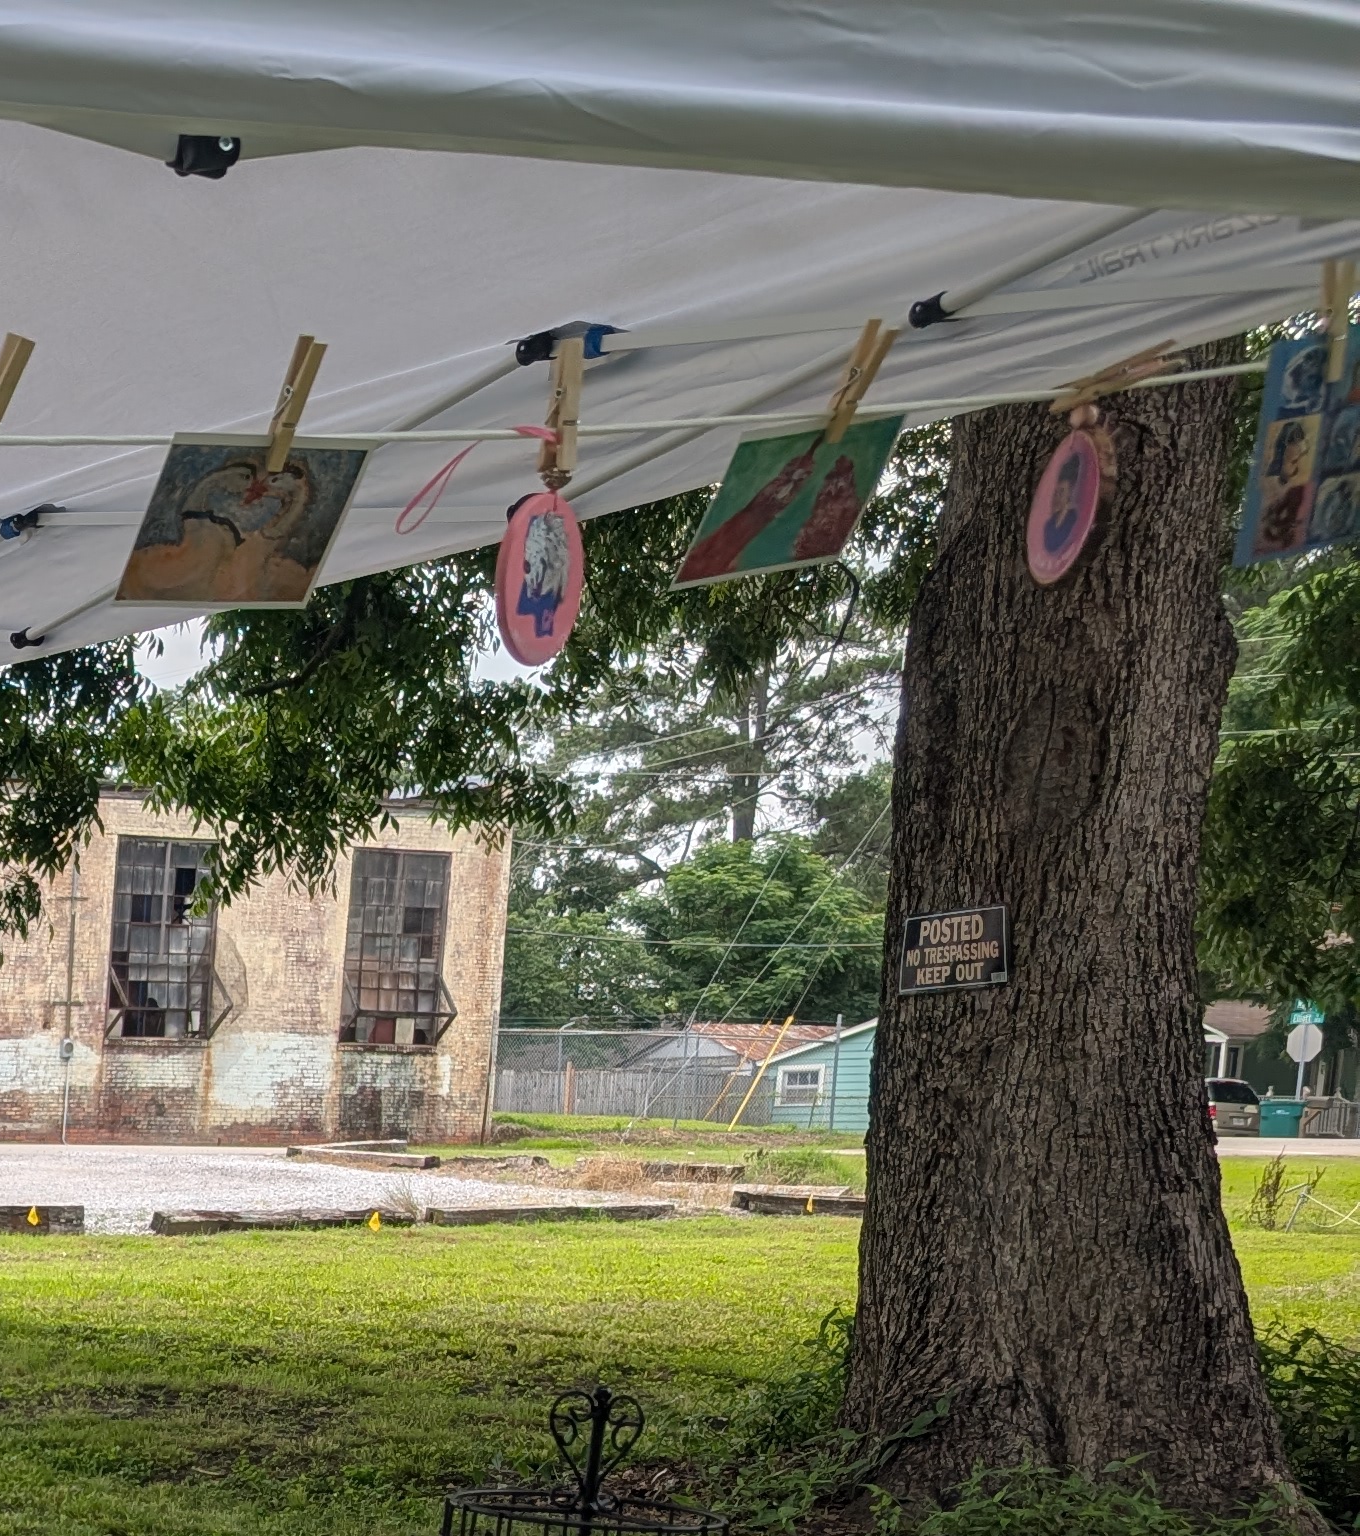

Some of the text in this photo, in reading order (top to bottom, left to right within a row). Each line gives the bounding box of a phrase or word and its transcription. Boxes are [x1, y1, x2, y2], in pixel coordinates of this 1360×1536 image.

[918, 914, 984, 946] POSTED
[906, 941, 999, 967] NO TRESPASSING
[917, 962, 984, 985] KEEP OUT
